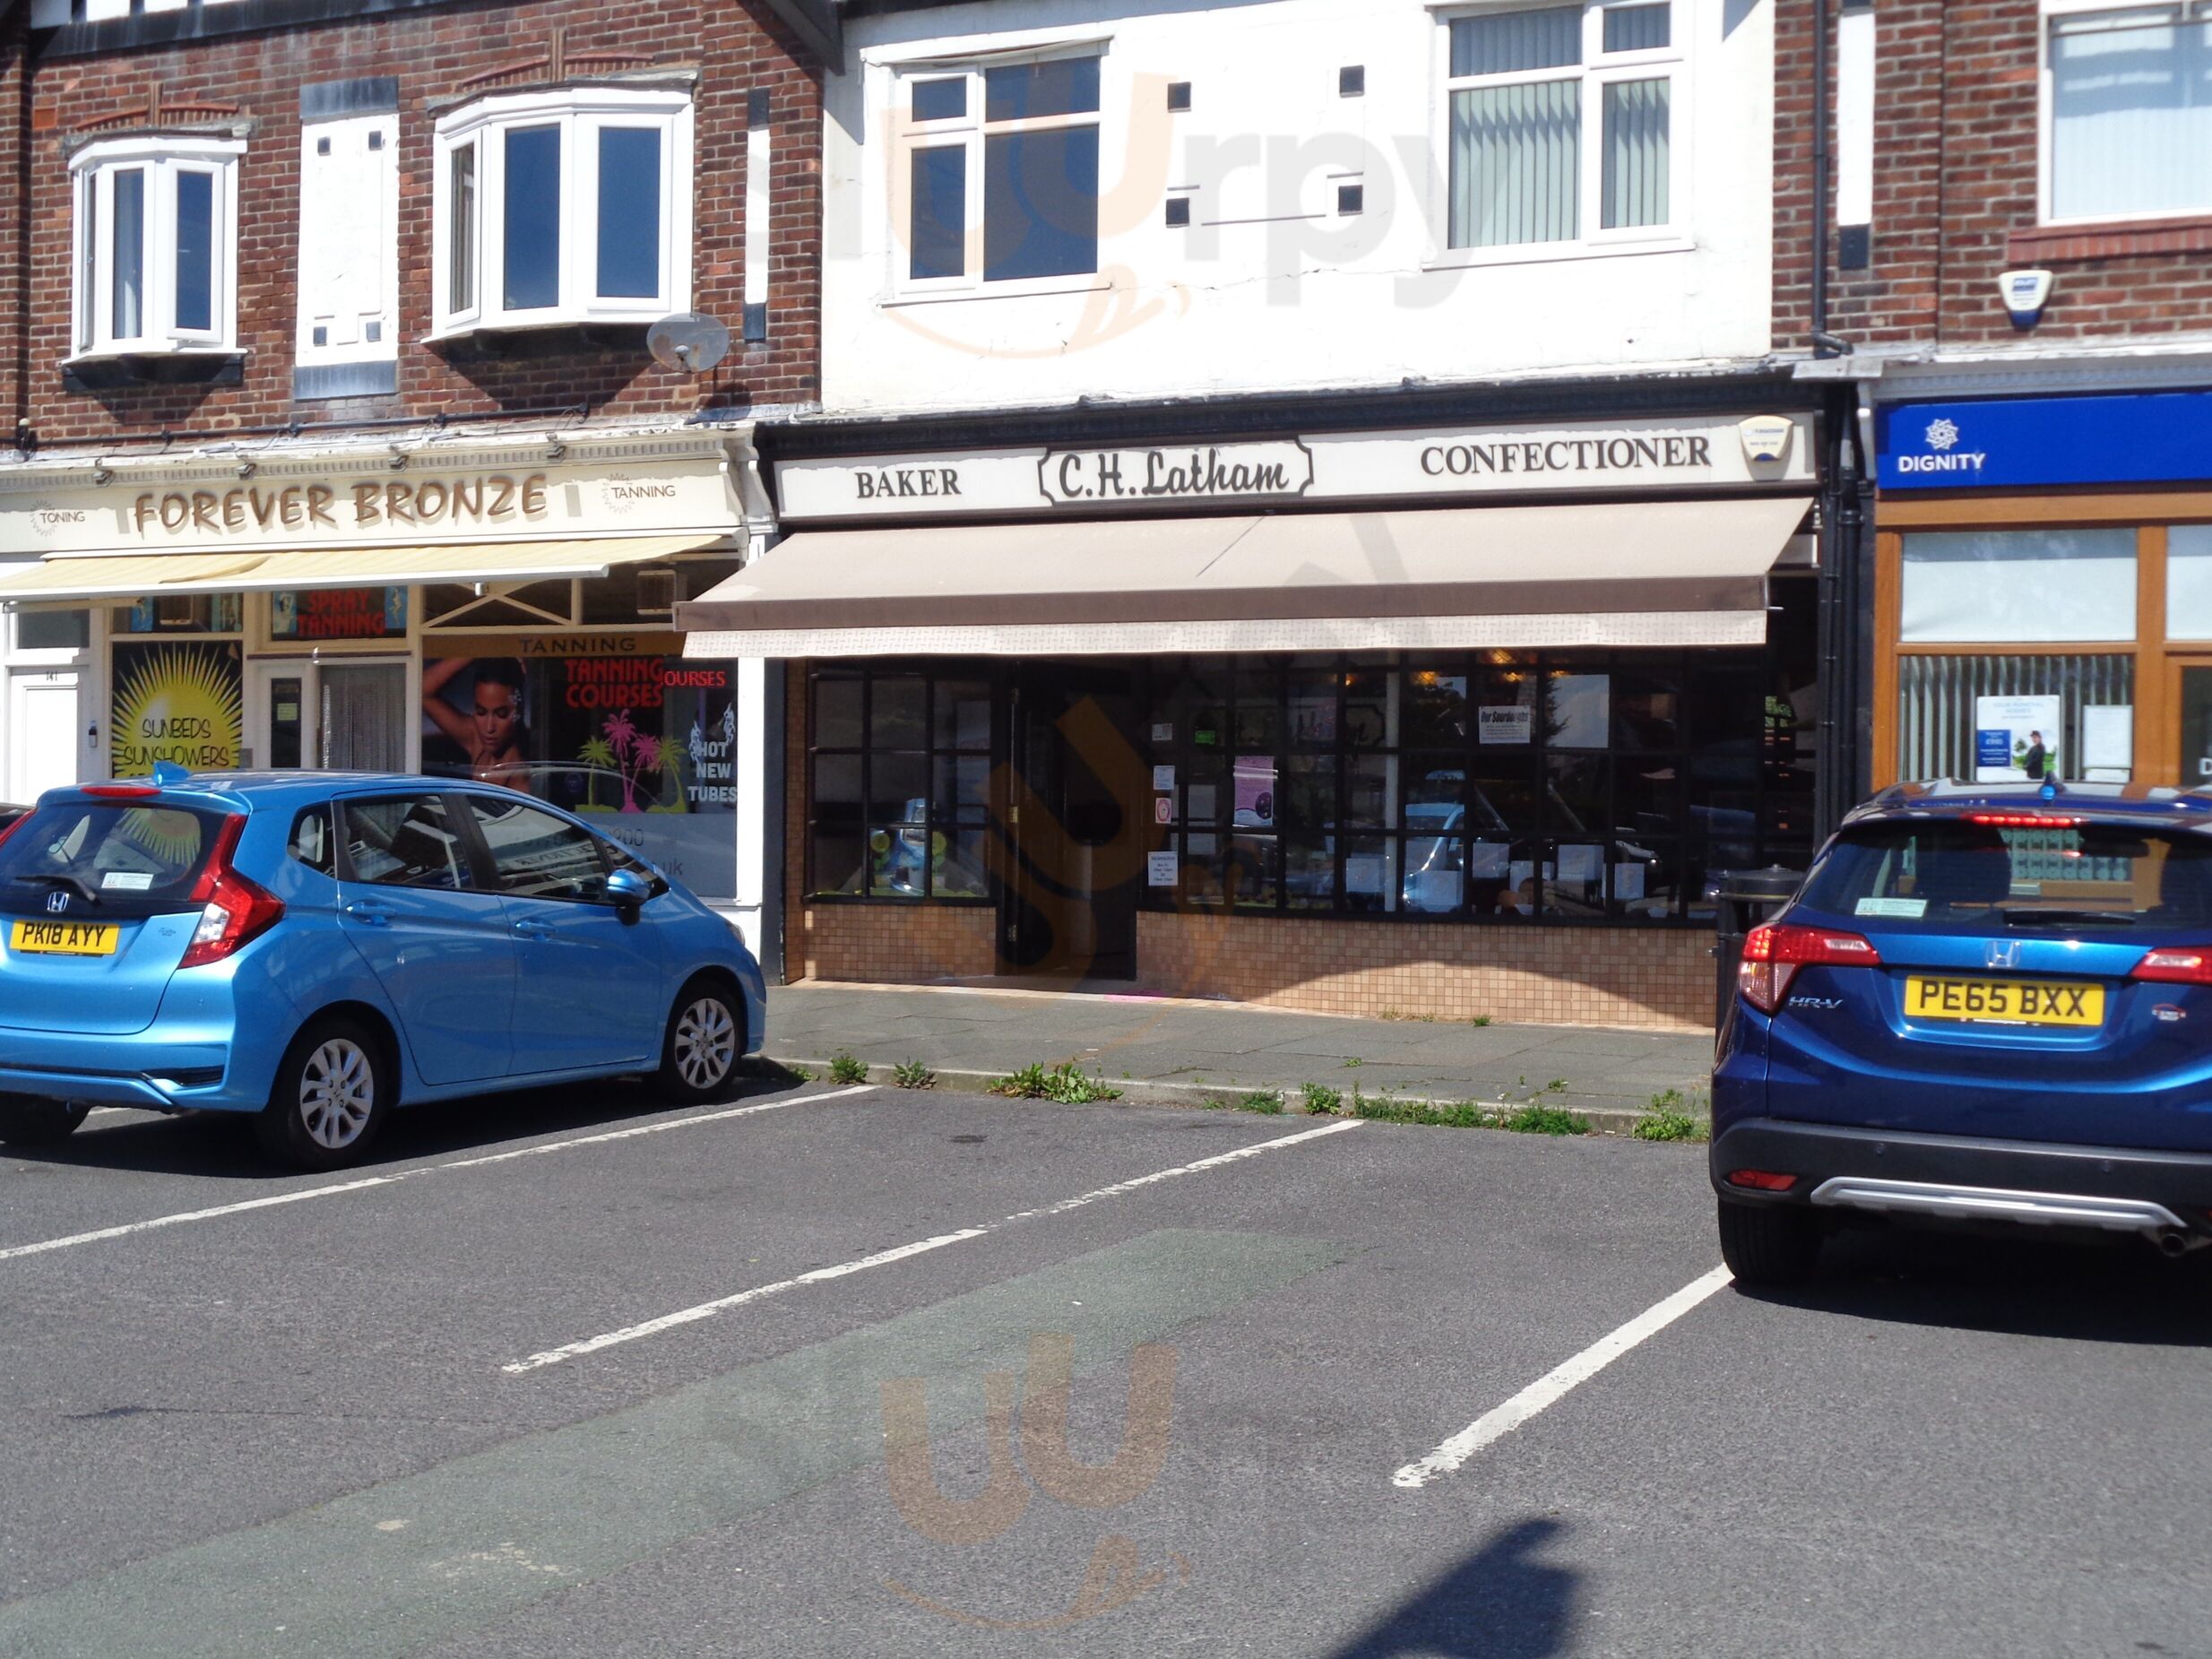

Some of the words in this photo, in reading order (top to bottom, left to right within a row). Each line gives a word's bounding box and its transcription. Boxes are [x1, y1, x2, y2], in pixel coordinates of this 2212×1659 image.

[1421, 436, 1712, 476] CONFECTIONER
[1897, 453, 1986, 472] DIGNITY
[611, 485, 676, 499] TANNING
[855, 469, 963, 498] BAKER
[134, 485, 336, 531] FOREVER
[350, 474, 547, 523] BRONZE
[39, 512, 85, 523] TONING
[308, 588, 371, 612] SPRAY
[297, 610, 386, 636] TANNING
[520, 637, 636, 653] TANNING
[565, 659, 664, 682] TANNING
[661, 671, 726, 687] OURSES
[566, 684, 663, 708] COURSES
[143, 718, 212, 739] SUNBEDS
[124, 746, 229, 766] SUNSHOWERS
[701, 741, 727, 757] HOT
[696, 763, 730, 778] NEW
[687, 786, 738, 801] TUBES
[22, 923, 62, 945] PK18
[68, 924, 107, 946] AYY
[1920, 981, 2009, 1013] PE65
[2019, 986, 2087, 1017] BXX
